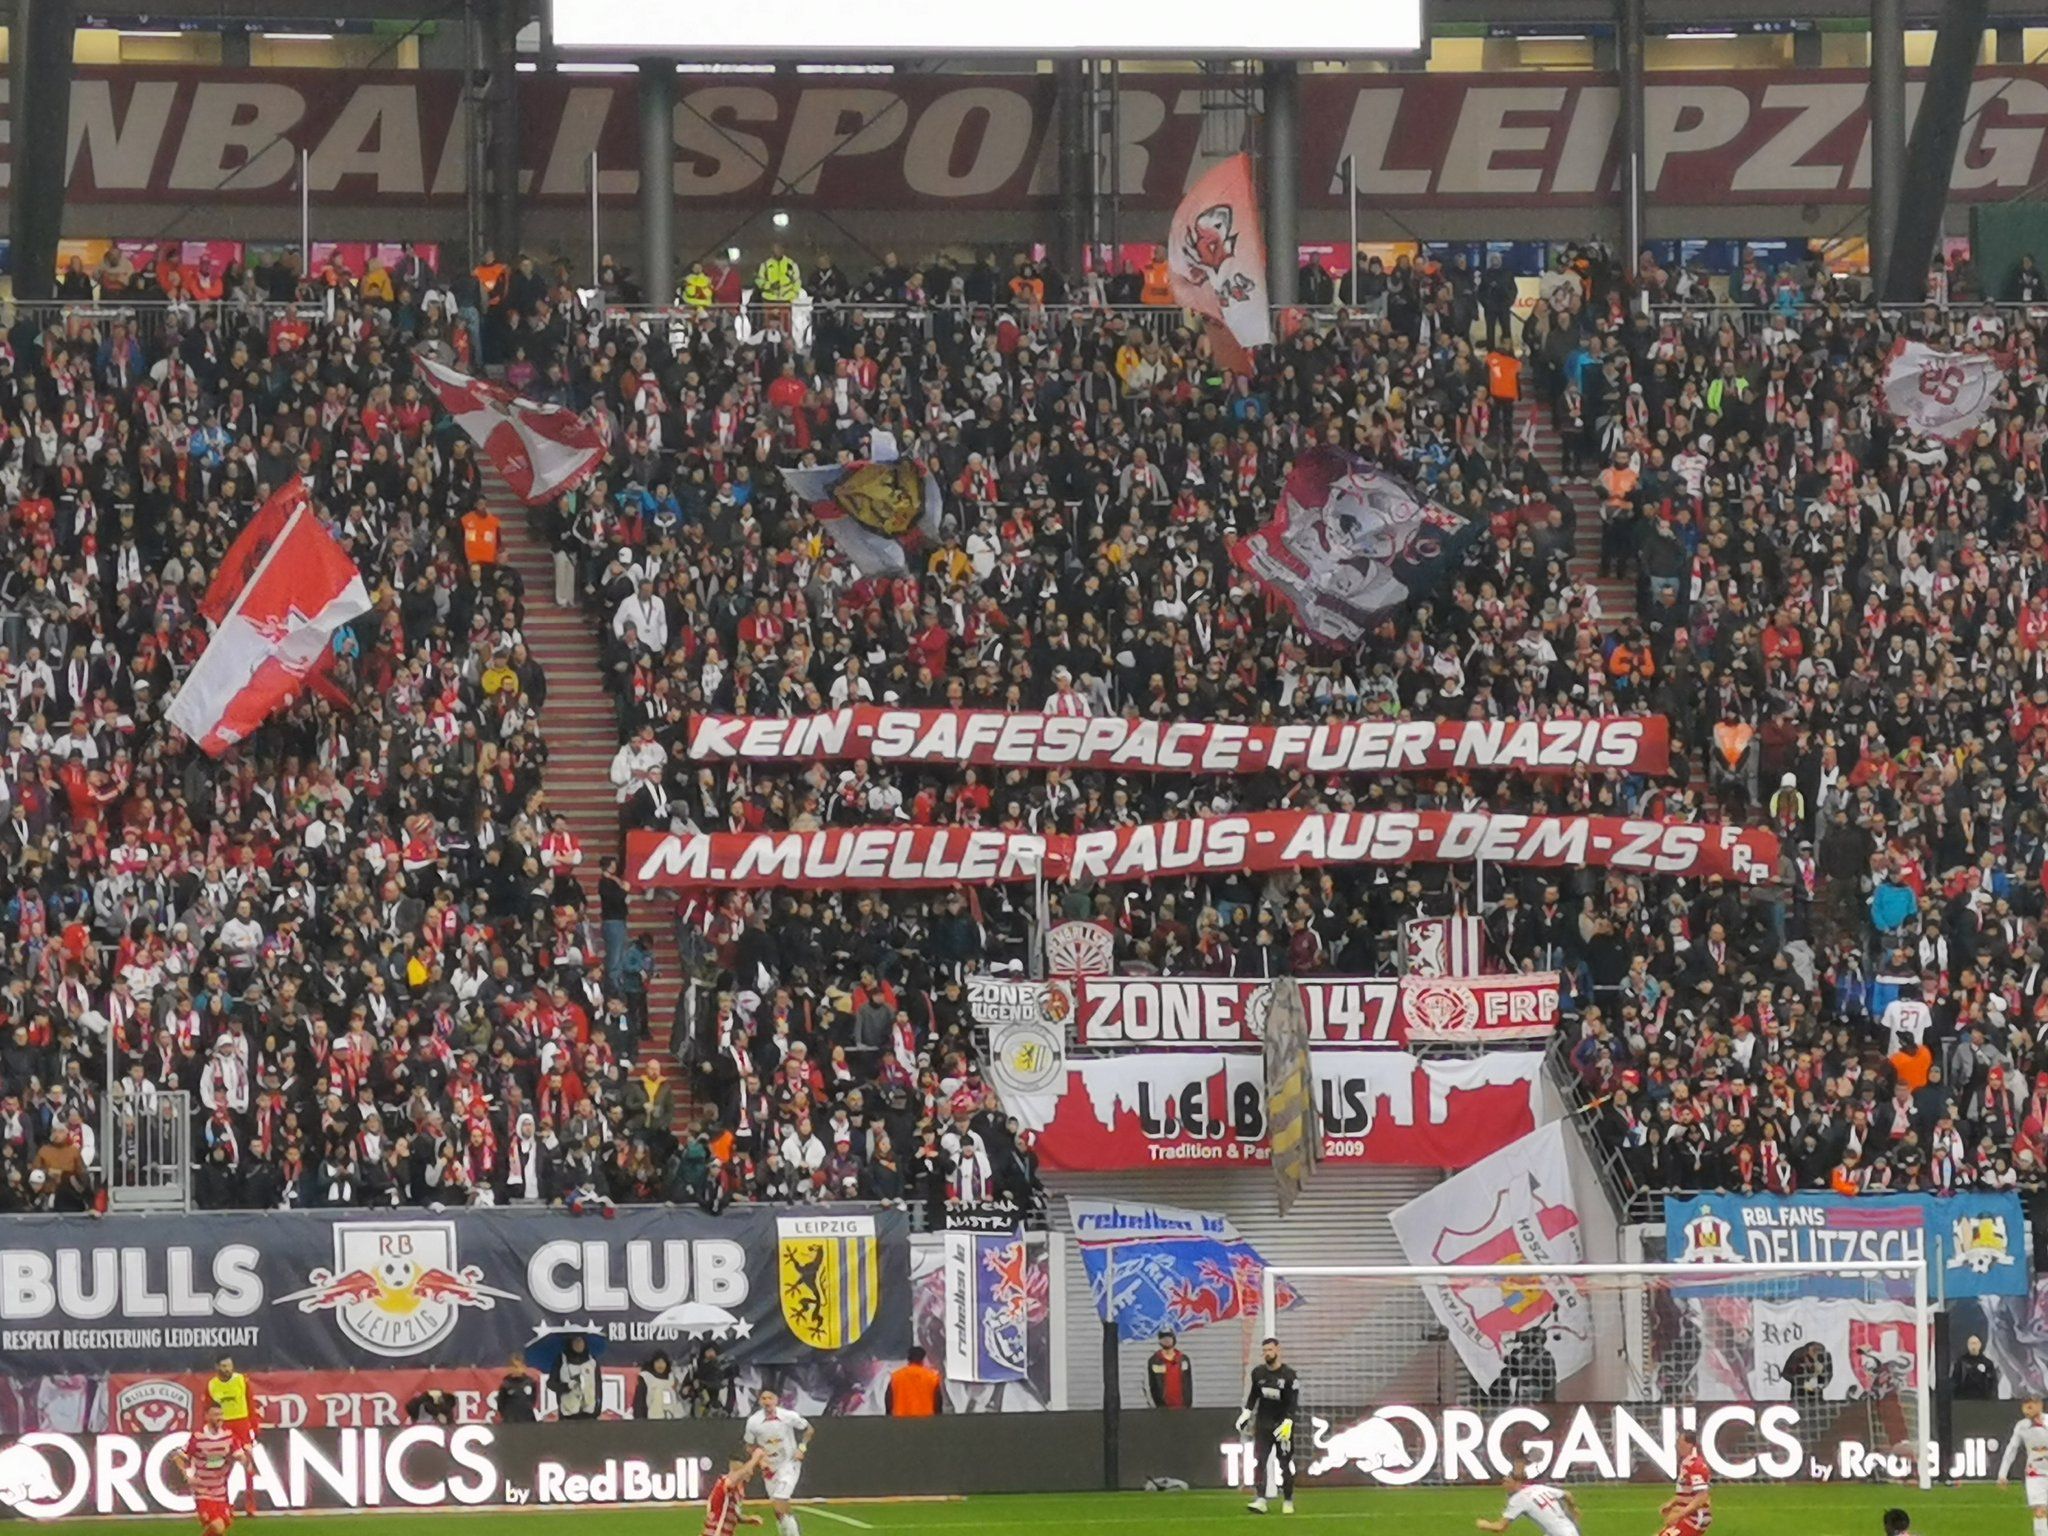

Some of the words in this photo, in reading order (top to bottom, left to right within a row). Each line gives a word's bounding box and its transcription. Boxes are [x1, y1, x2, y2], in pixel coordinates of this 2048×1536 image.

[688, 708, 852, 760] KEIN
[871, 712, 1248, 769] SAFESPACE
[1267, 720, 1436, 771] FUER
[1452, 719, 1642, 768] NAZIS
[1069, 816, 1249, 880] RAUS
[1281, 813, 1417, 861] AUS
[1436, 814, 1588, 864] DEM
[1611, 824, 1705, 871] ZS
[967, 982, 1034, 1005] ZONE
[1086, 982, 1241, 1041] ZONE
[1306, 984, 1398, 1041] 147
[1484, 988, 1560, 1025] FRP
[1900, 1010, 1920, 1029] 27
[1148, 1143, 1222, 1160] Tradition
[1226, 1143, 1239, 1160] &
[1325, 1140, 1364, 1157] 2009
[794, 1220, 859, 1234] LEIPZIG
[1741, 1206, 1779, 1227] RBL
[1780, 1205, 1826, 1227] FANS
[379, 1233, 414, 1256] RB
[0, 1243, 263, 1320] BULLS
[527, 1239, 748, 1314] CLUB
[2, 1329, 61, 1351] RESPEKT
[63, 1328, 162, 1350] BEGEISTERUNG
[164, 1326, 260, 1348] LEIDENSCHAFT
[357, 1309, 438, 1343] LEIPZIG
[608, 1322, 627, 1342] RB
[1761, 1321, 1804, 1346] Red
[316, 1390, 498, 1427] PIRES
[1370, 1405, 1803, 1485] ORGANCS
[1811, 1455, 1834, 1482] by
[505, 1479, 531, 1504] by
